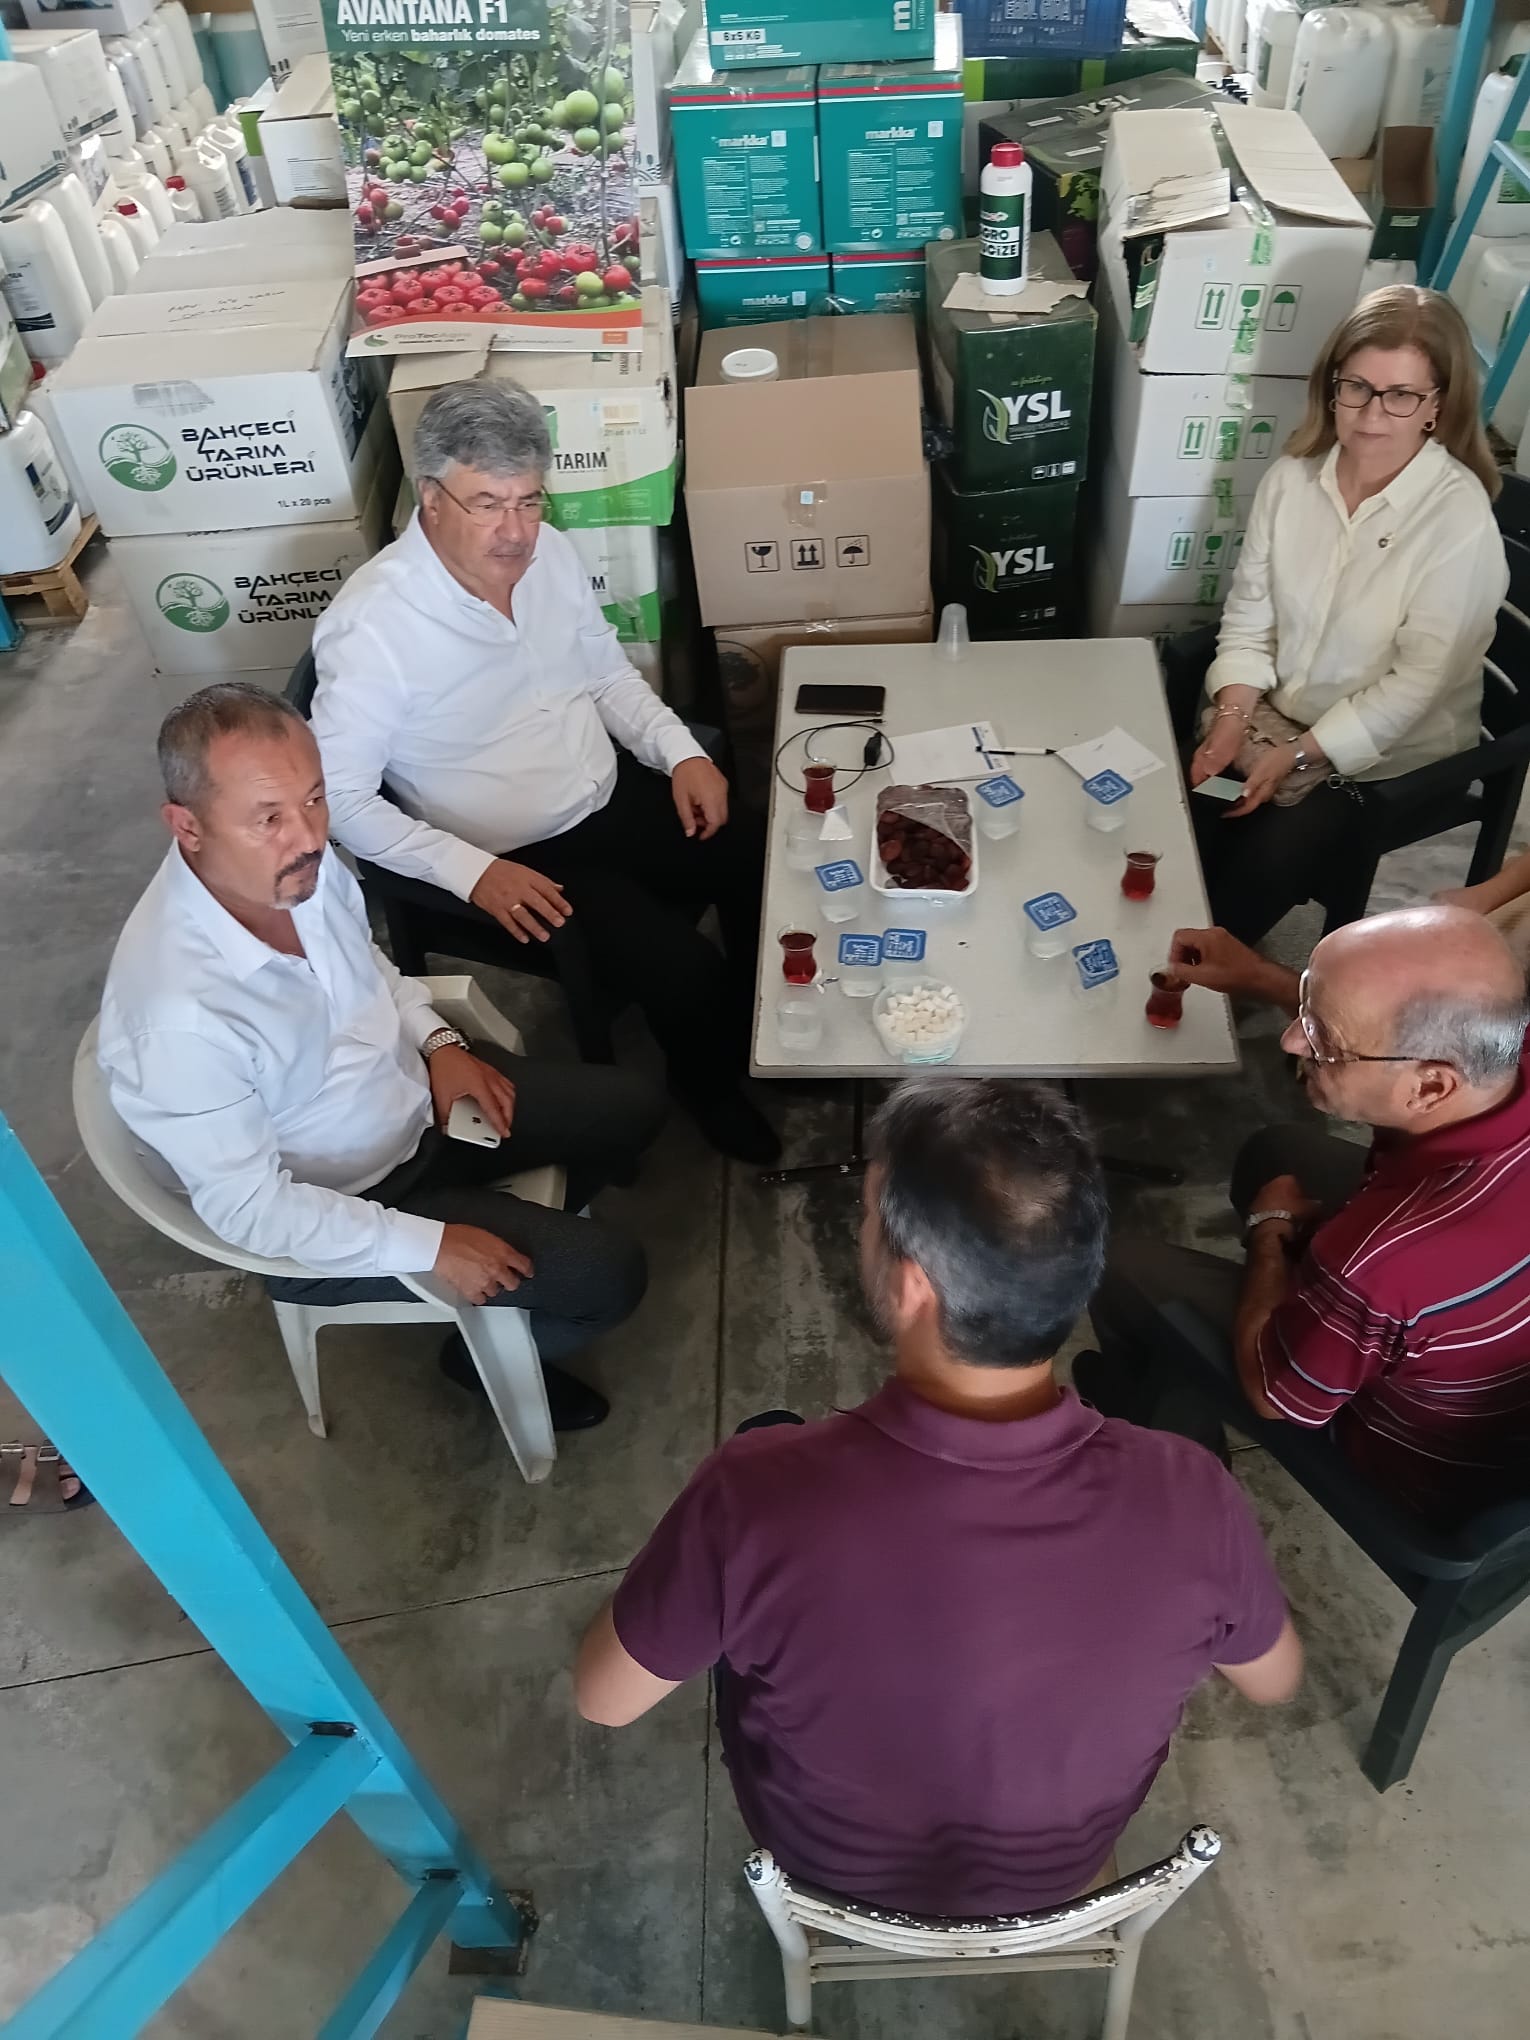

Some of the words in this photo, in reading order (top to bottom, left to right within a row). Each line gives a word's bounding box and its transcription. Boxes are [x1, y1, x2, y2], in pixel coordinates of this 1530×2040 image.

[336, 0, 474, 25] AVANTANA
[479, 0, 508, 24] F1
[341, 29, 370, 42] Yeni
[372, 29, 408, 42] erken
[475, 28, 541, 42] domates
[746, 30, 762, 40] KG
[982, 227, 1009, 241] GRO
[1001, 390, 1072, 426] YSL
[198, 444, 286, 463] TARIM
[554, 452, 608, 470] TARIM
[991, 545, 1055, 577] YSL
[249, 589, 333, 607] TARIM
